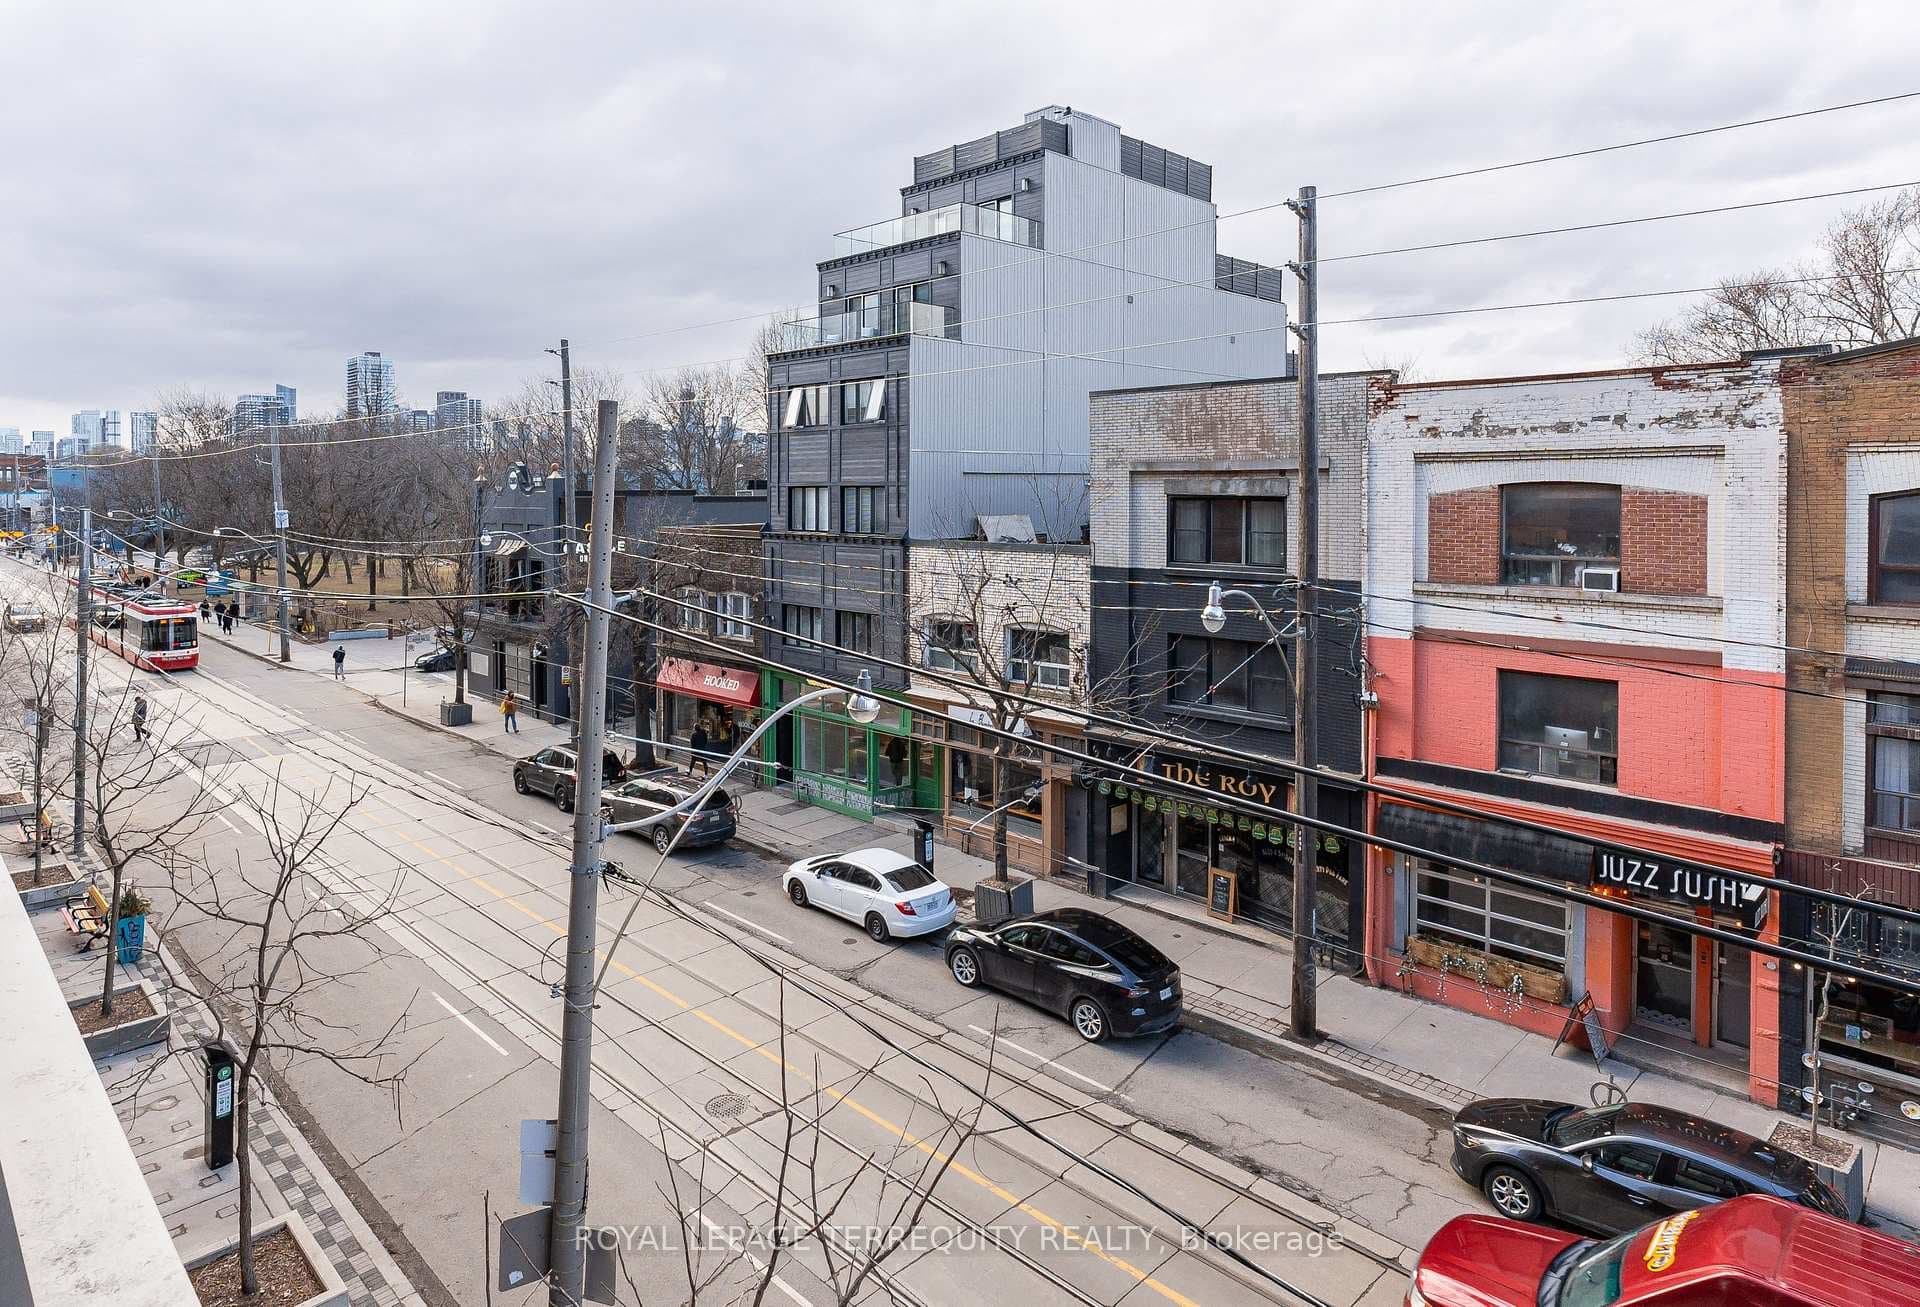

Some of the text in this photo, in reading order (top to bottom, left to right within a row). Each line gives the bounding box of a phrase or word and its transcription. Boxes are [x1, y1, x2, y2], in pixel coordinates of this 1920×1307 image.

[704, 675, 740, 691] HOOKED
[1218, 774, 1278, 804] ROY
[1599, 854, 1660, 890] JUZZ
